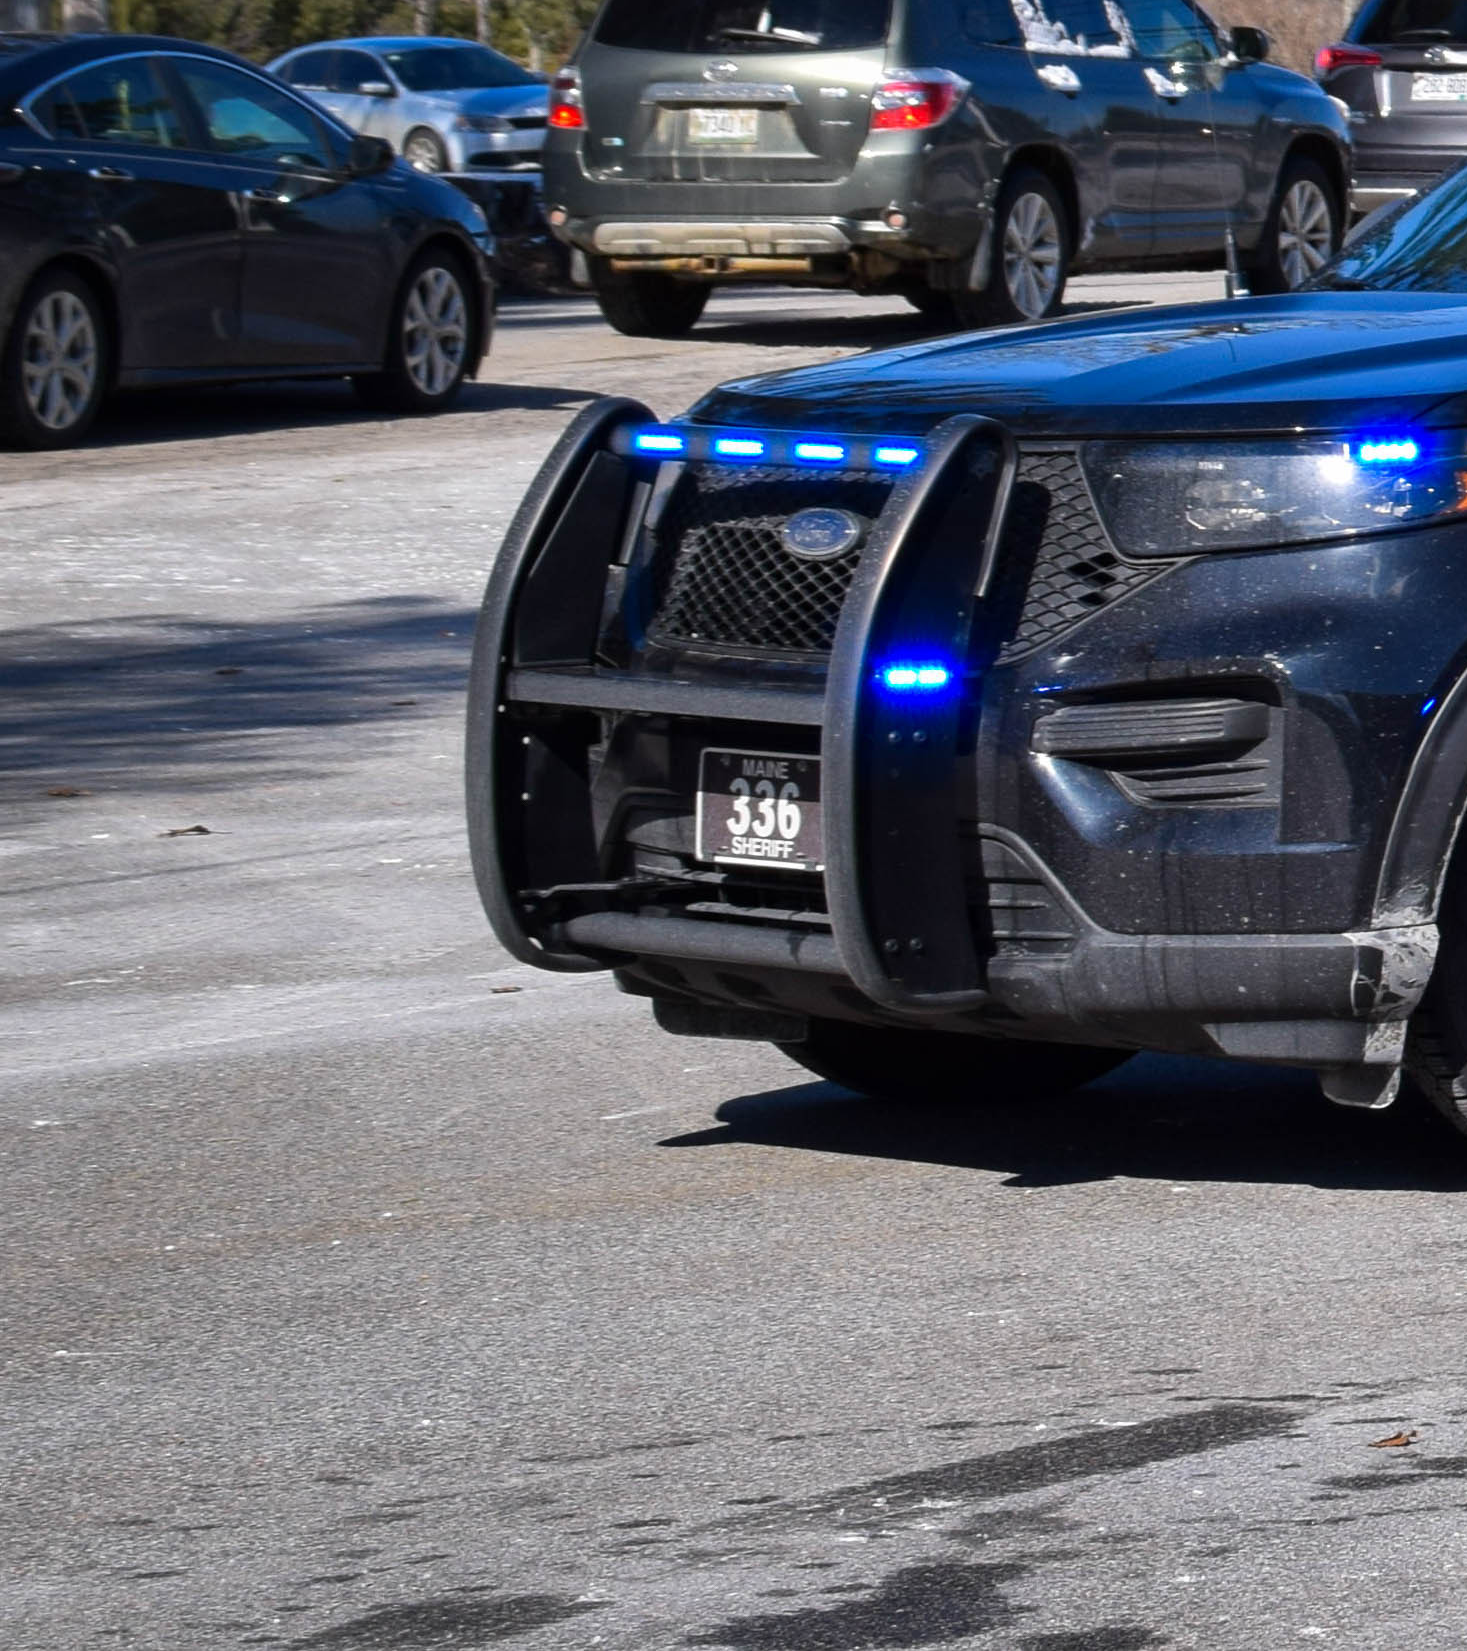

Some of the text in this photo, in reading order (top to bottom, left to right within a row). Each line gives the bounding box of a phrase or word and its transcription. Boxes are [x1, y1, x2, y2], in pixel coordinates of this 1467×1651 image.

[742, 759, 790, 779] MAINE
[726, 777, 801, 839] 336
[731, 836, 794, 858] SHERIFF
